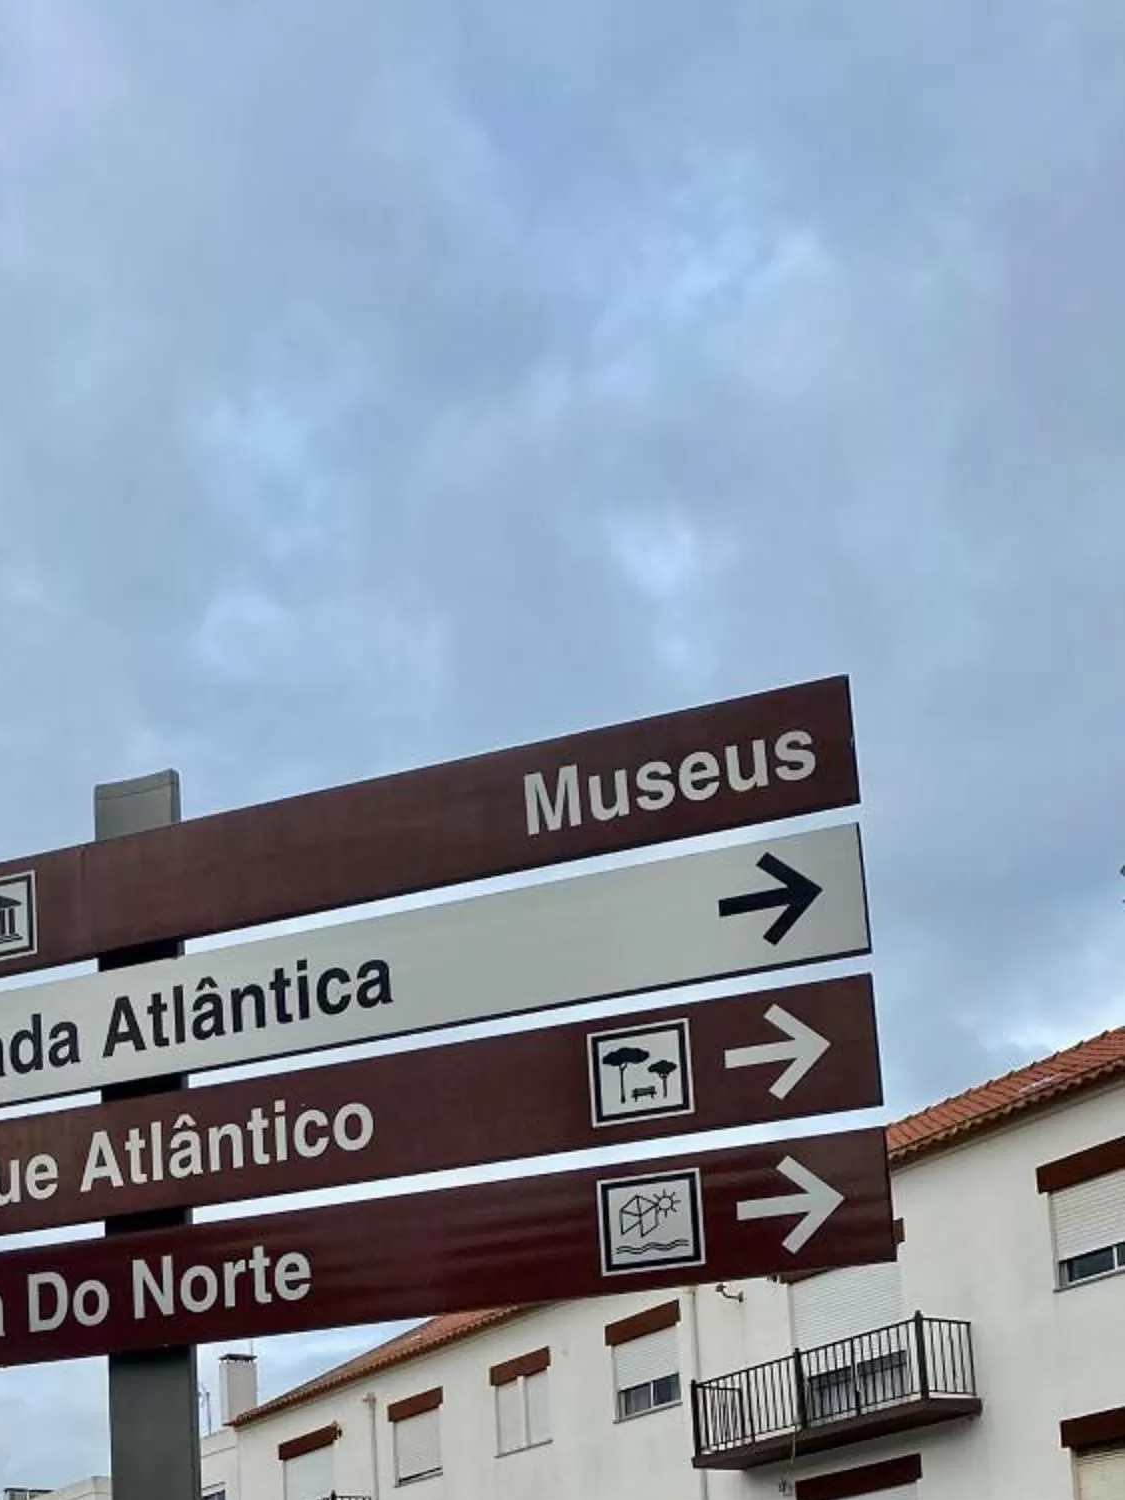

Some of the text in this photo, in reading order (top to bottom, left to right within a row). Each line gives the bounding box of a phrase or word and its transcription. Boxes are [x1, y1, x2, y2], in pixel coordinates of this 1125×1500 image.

[523, 731, 816, 836] Museus
[102, 960, 394, 1058] Atlântica
[80, 1100, 374, 1193] Atlântico
[27, 1272, 110, 1333] Do
[132, 1246, 311, 1320] Norte
